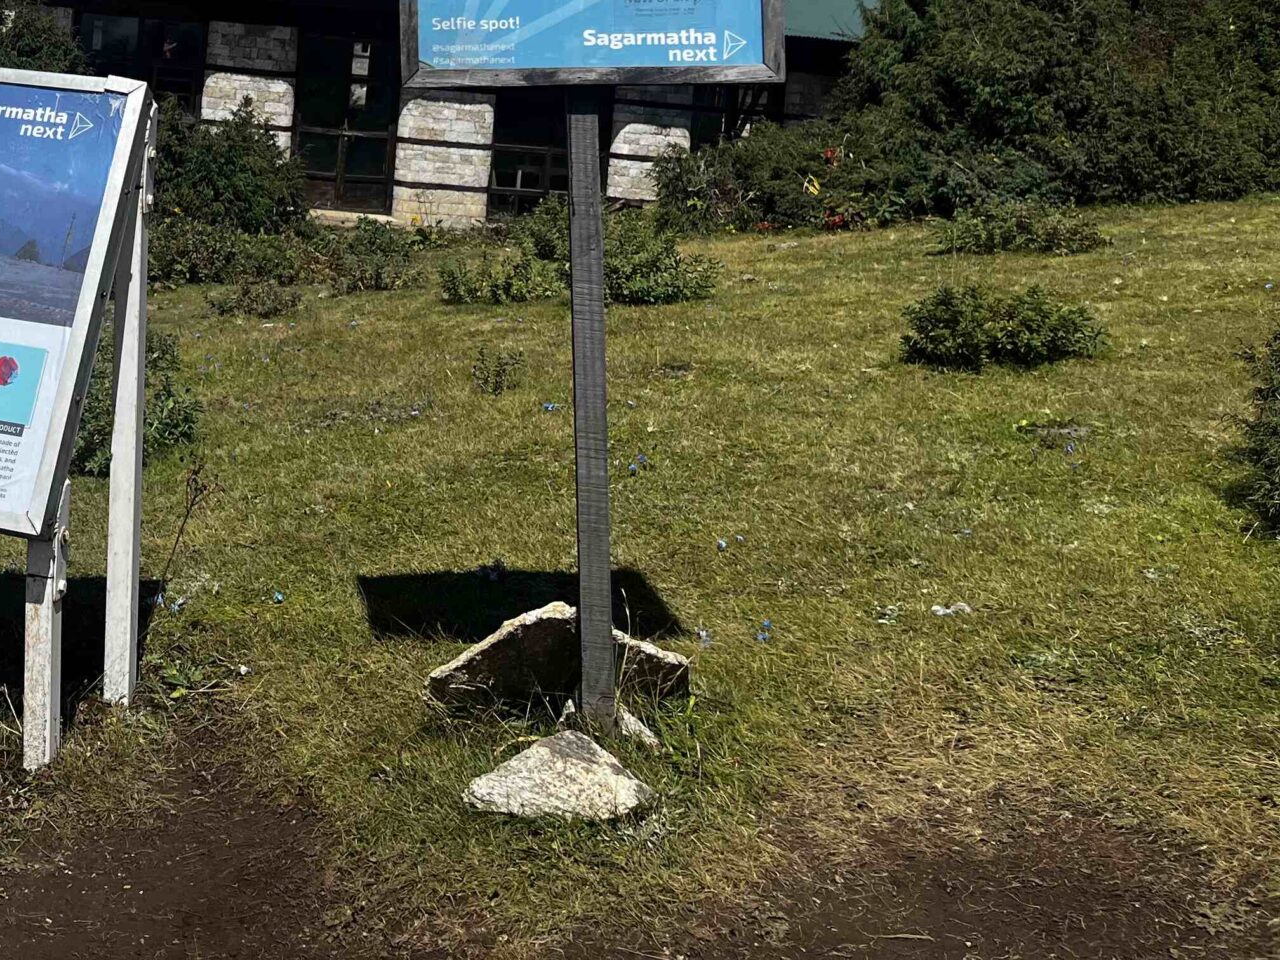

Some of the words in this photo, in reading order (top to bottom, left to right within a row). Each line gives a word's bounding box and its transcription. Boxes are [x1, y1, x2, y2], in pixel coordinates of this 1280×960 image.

[431, 17, 476, 31] Selfie
[480, 16, 520, 32] spot!
[583, 28, 717, 49] Sagarmatha
[669, 46, 717, 62] next
[20, 123, 65, 139] next
